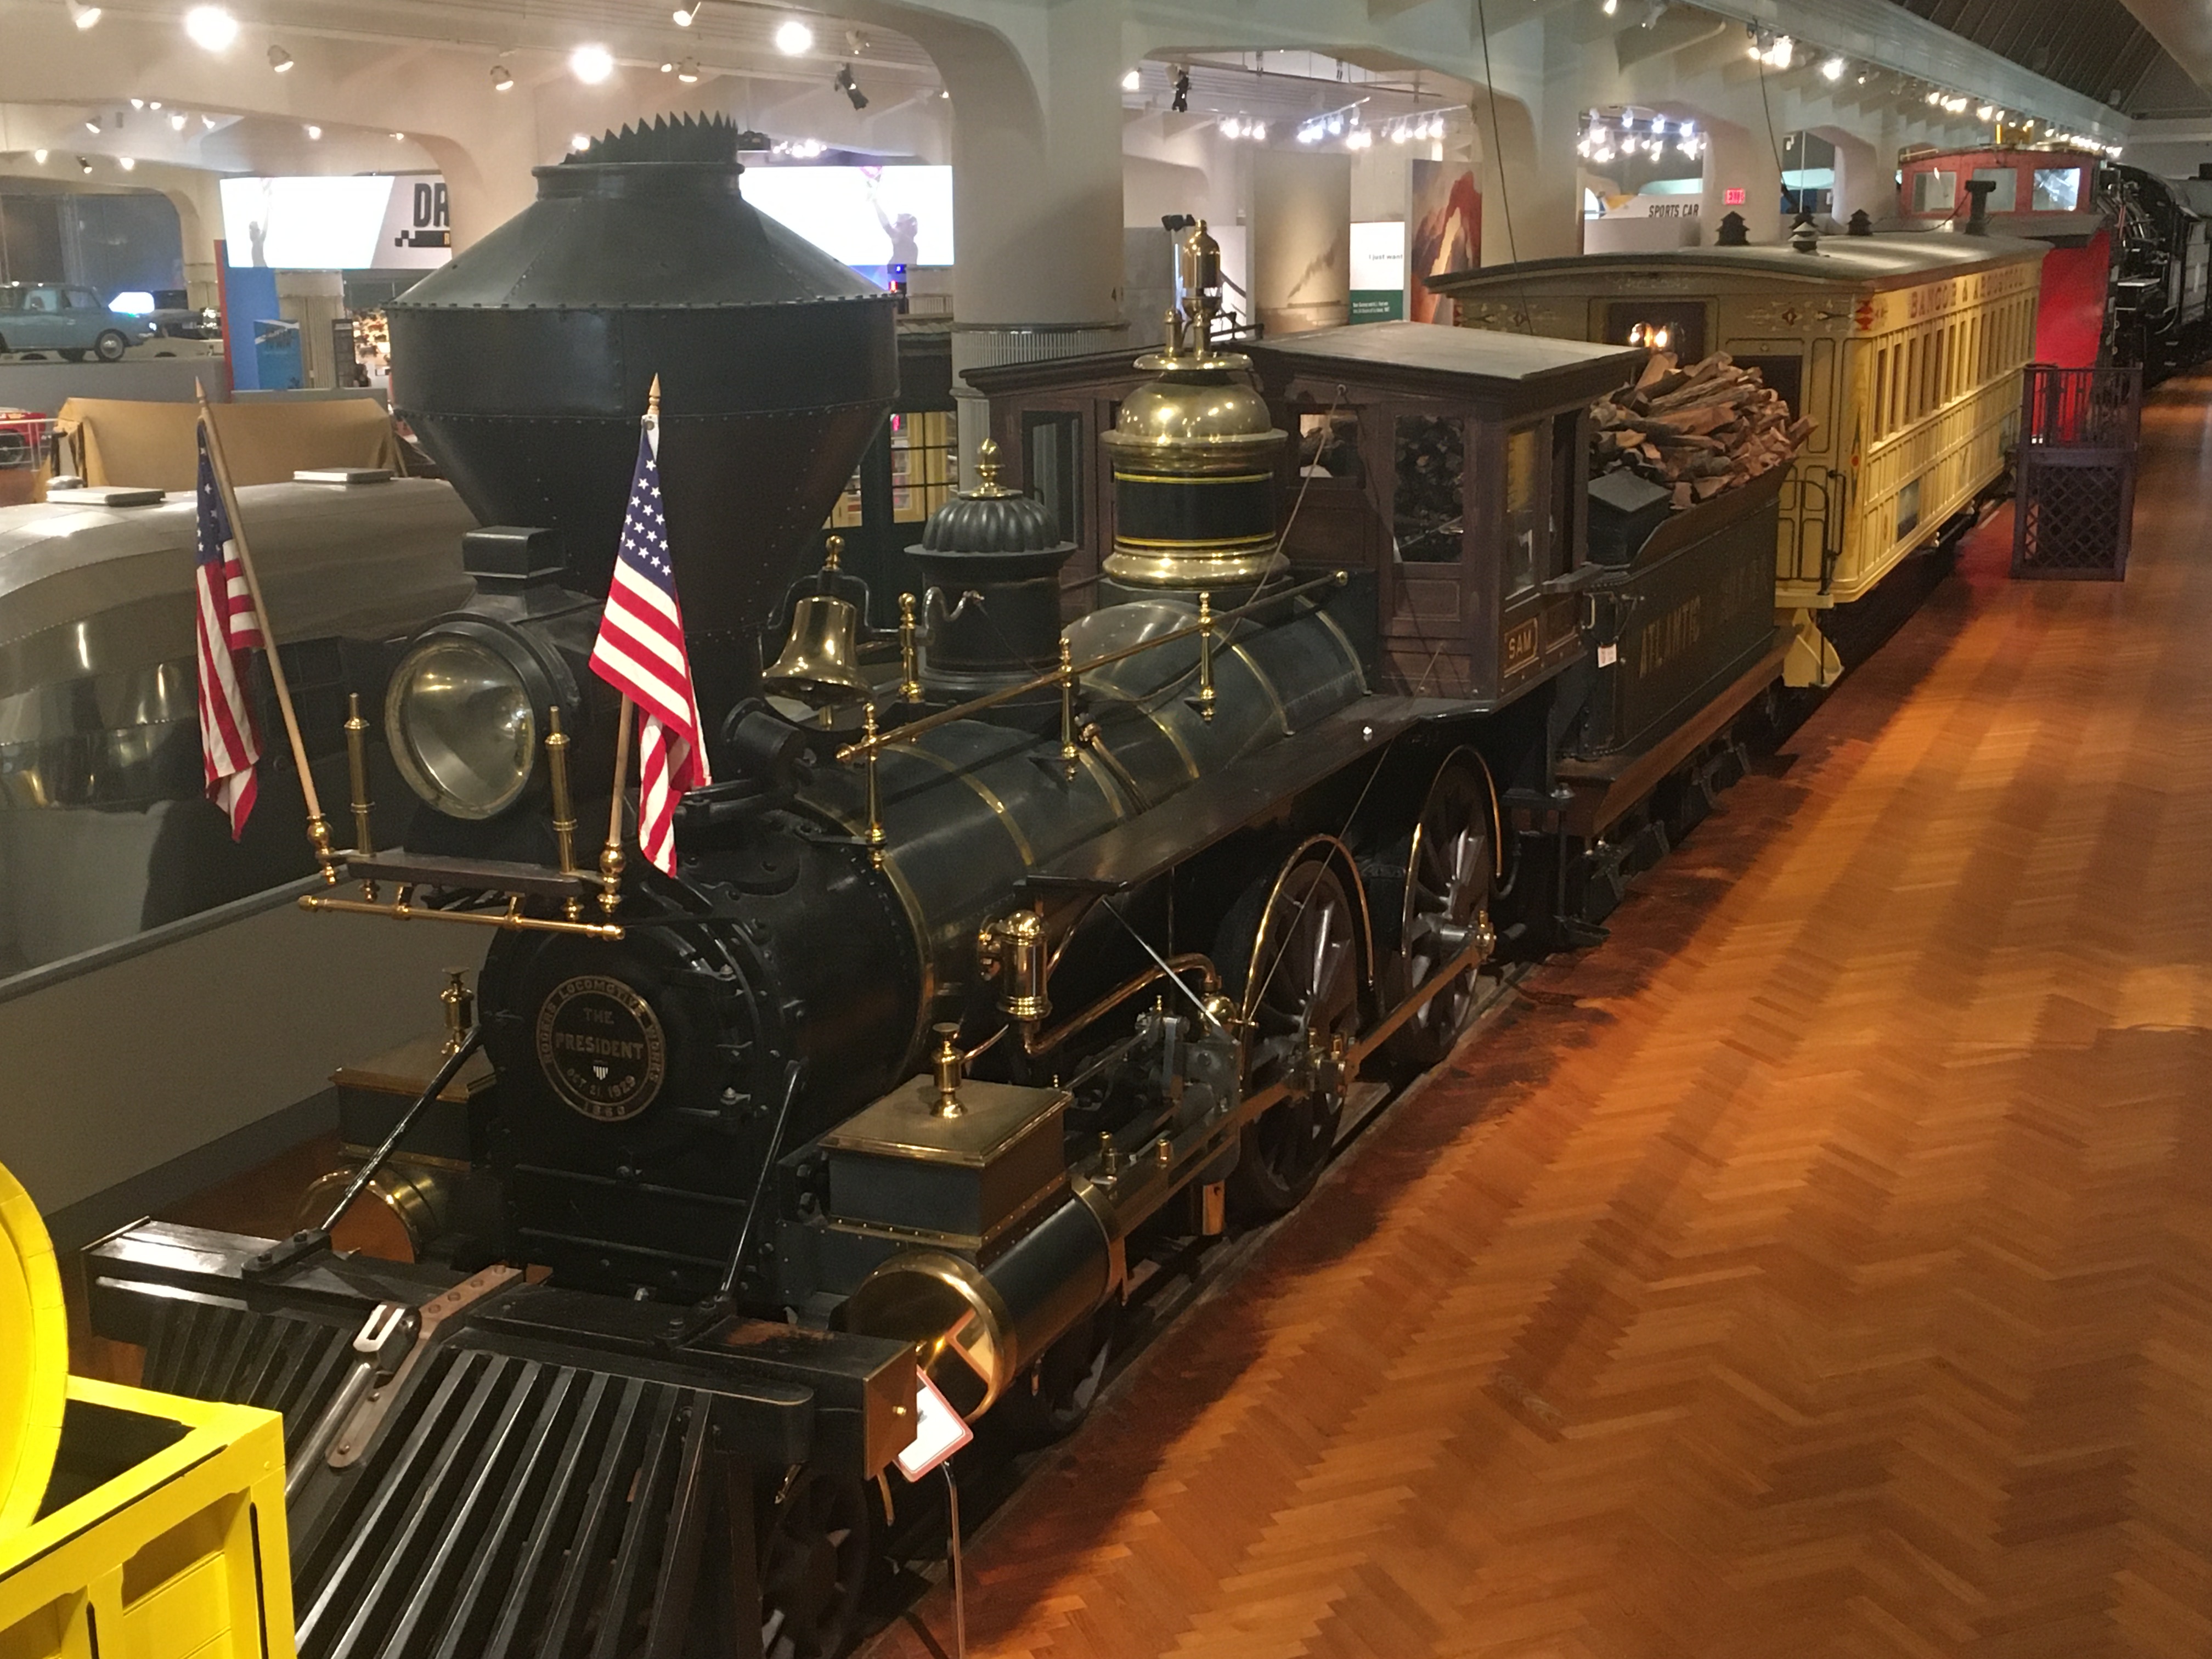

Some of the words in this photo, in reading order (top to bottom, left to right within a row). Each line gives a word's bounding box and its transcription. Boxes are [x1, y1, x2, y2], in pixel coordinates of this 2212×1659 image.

[1726, 190, 1743, 202] EXIT
[1649, 205, 1680, 218] SPORTS
[1682, 204, 1700, 217] CAR
[1508, 629, 1532, 659] SAM
[583, 1007, 615, 1025] THE
[558, 979, 645, 1018] LOCOMOTIVE
[645, 1024, 660, 1083] WORKS
[554, 1032, 644, 1060] PRESIDENT
[608, 1075, 636, 1098] 1929
